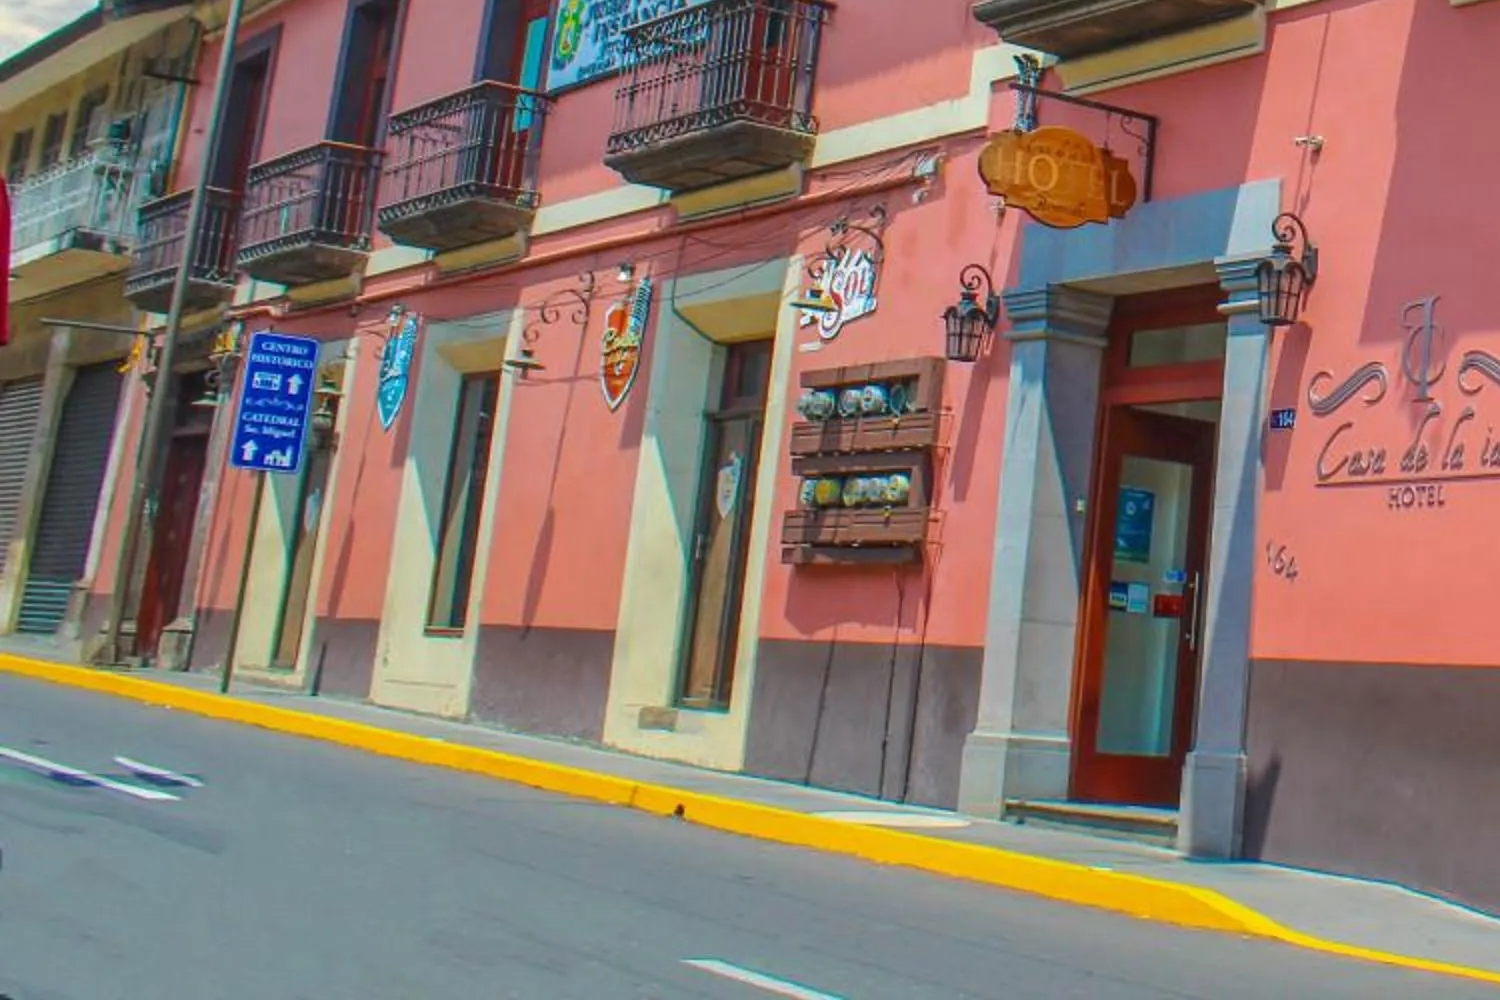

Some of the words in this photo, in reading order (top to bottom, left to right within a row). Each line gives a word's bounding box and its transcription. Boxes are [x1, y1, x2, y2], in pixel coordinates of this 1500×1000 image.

[261, 341, 308, 354] CENTRO
[242, 411, 300, 426] CATEDRAL
[1317, 422, 1387, 480] Casa
[1400, 403, 1441, 473] de
[1441, 405, 1475, 472] la
[1388, 485, 1445, 509] HOTEL
